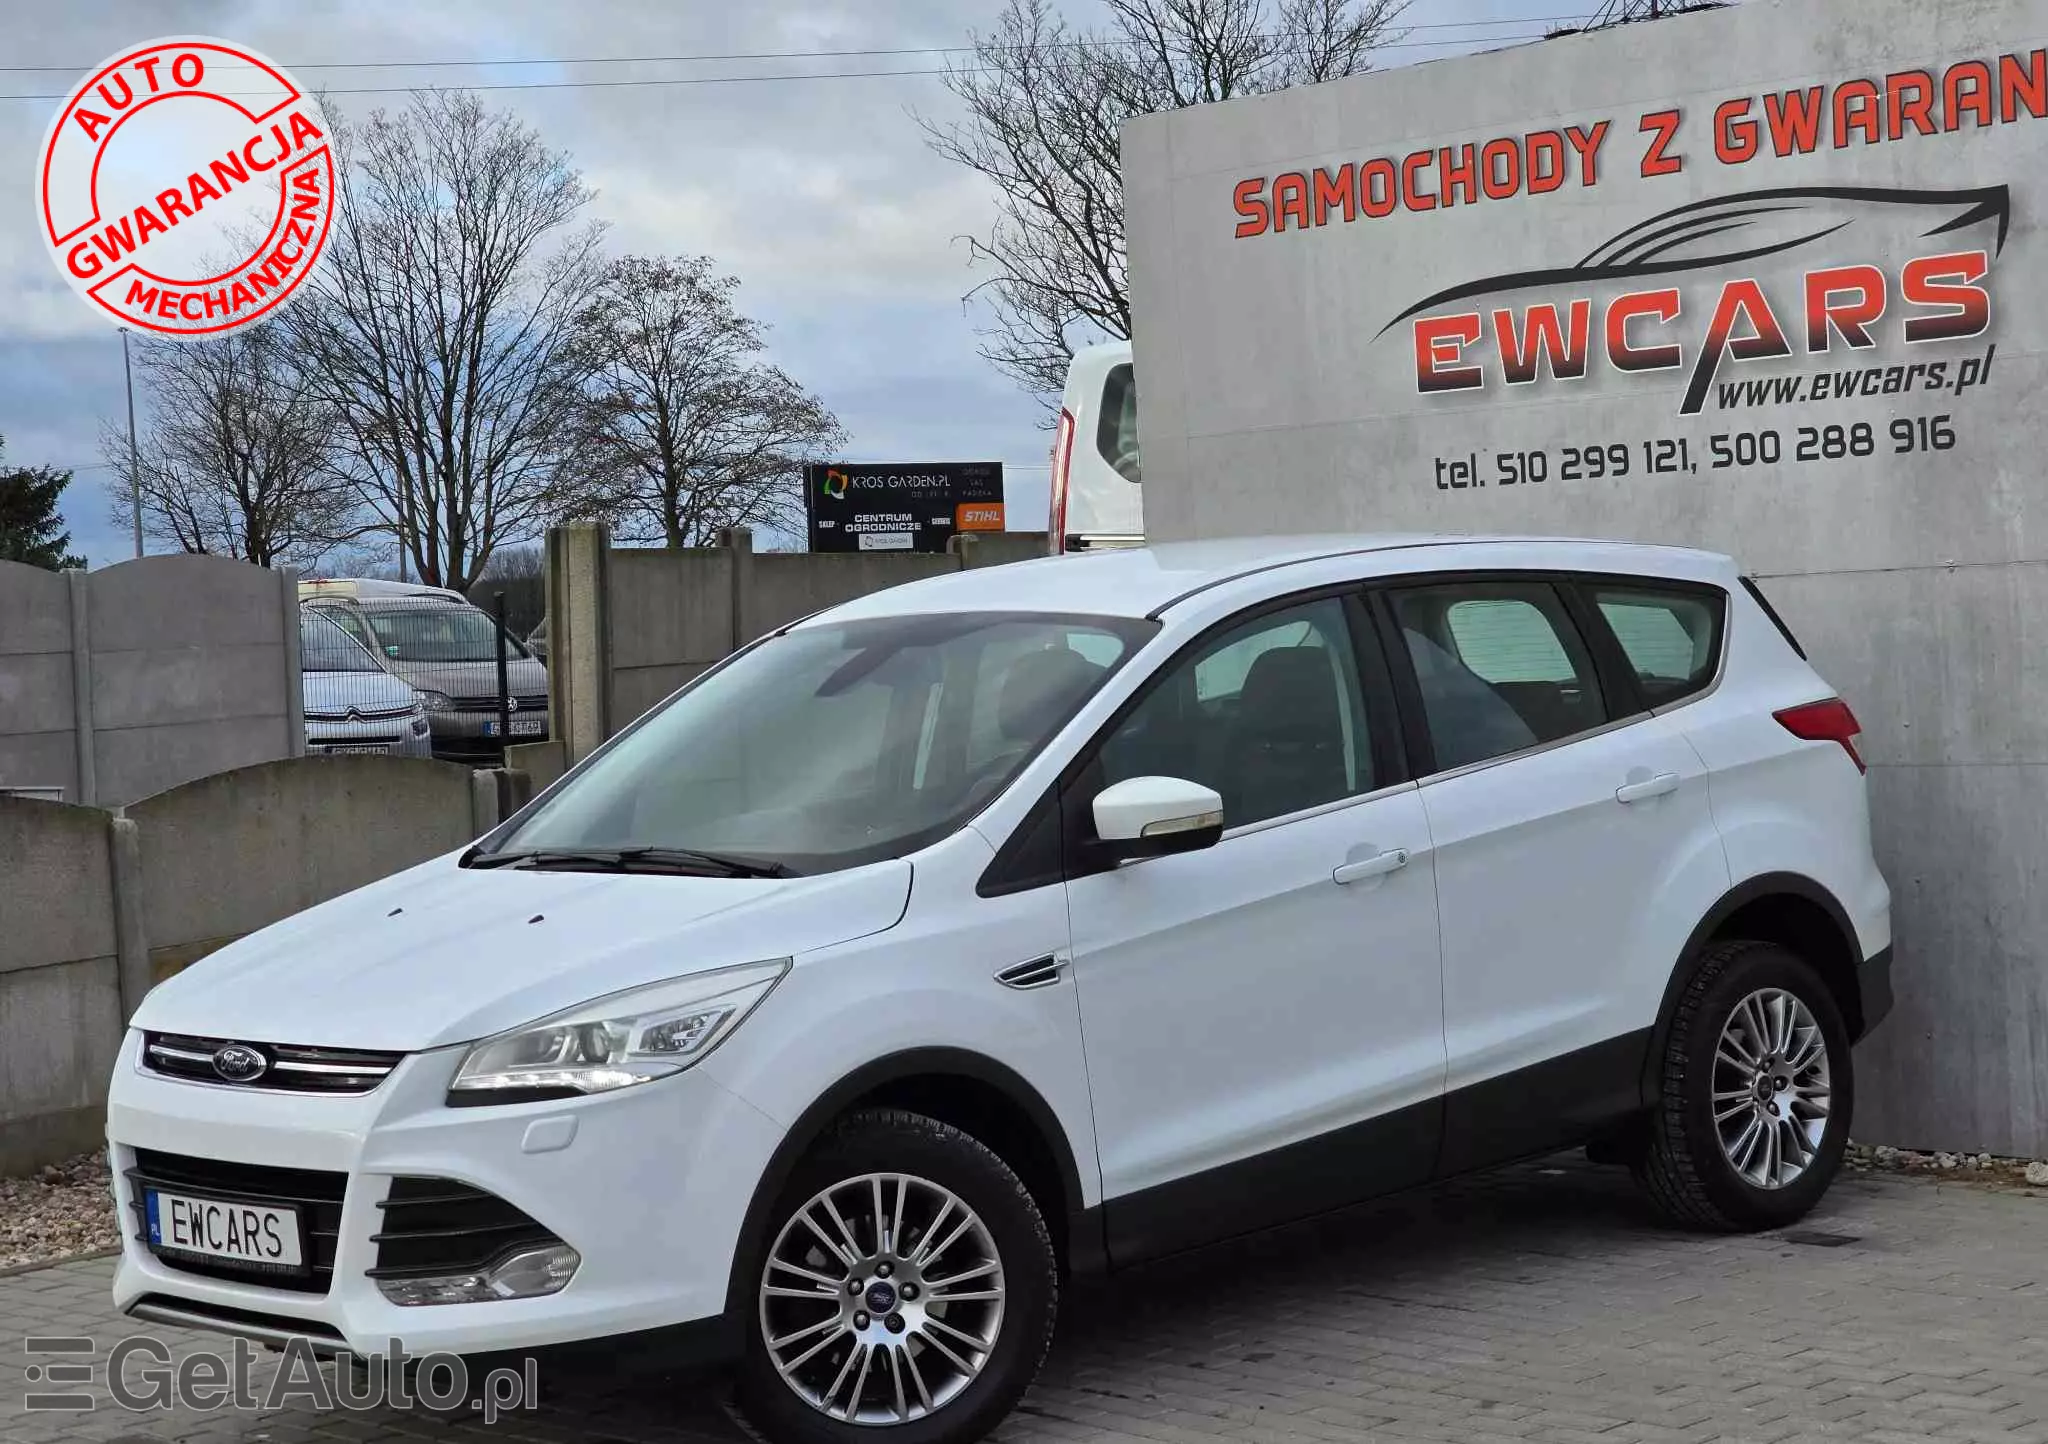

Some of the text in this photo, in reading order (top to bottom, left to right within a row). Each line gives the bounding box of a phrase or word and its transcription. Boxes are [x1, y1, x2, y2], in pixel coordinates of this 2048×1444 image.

[1233, 48, 2048, 238] SAMOCHODY Z GWARAN
[1413, 250, 1990, 416] EWCARS
[1717, 344, 1996, 410] www.ewcars.pl
[852, 474, 950, 488] KROS GARDEN.PL
[1435, 415, 1956, 490] tel. 510 299 121, 500 288 916
[845, 522, 921, 532] OGRODNICZE
[855, 513, 912, 522] CENTRUM
[965, 511, 1000, 522] STIHL
[171, 1199, 282, 1258] EWCARS
